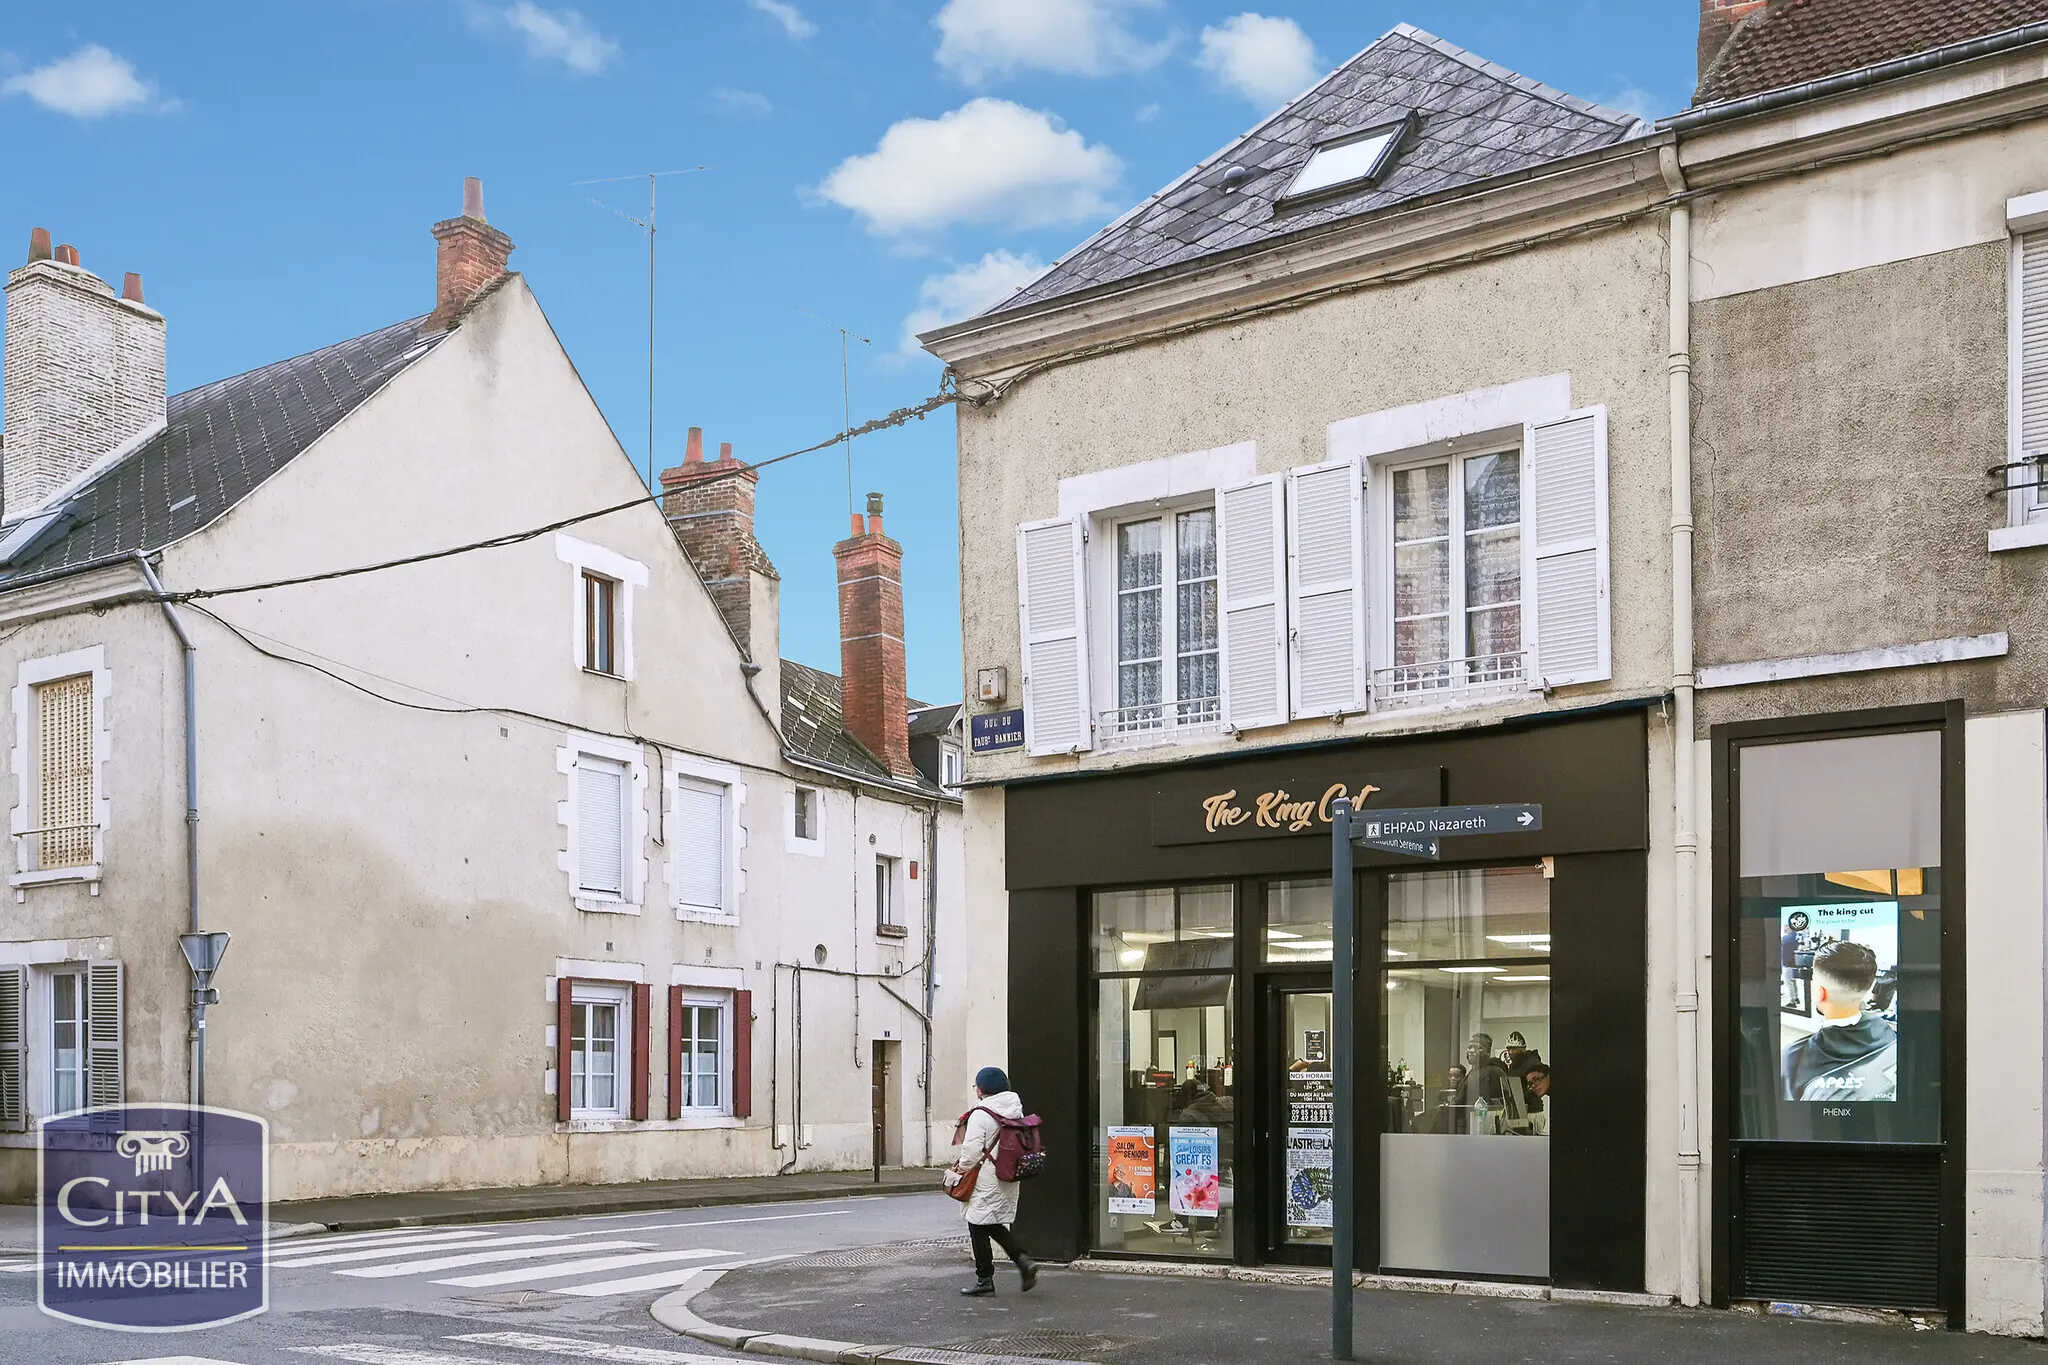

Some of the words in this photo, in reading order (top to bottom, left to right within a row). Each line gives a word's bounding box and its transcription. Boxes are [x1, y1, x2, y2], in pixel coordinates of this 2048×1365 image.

[984, 718, 998, 728] RUE
[1002, 716, 1012, 726] DU
[994, 731, 1022, 744] BANNIER
[1202, 789, 1251, 832] The
[1255, 789, 1316, 832] King
[1383, 822, 1425, 835] EHPAD
[1429, 816, 1486, 831] Nazareth
[1836, 908, 1857, 917] king
[1815, 1072, 1866, 1089] APRÈS
[1823, 1107, 1851, 1117] PHENIX
[1116, 1142, 1135, 1150] SALON
[1189, 1145, 1212, 1154] LOISIRS
[1287, 1138, 1334, 1150] L'ASTROLA
[1123, 1150, 1149, 1158] SENIORS
[1175, 1154, 1212, 1166] CREATFS
